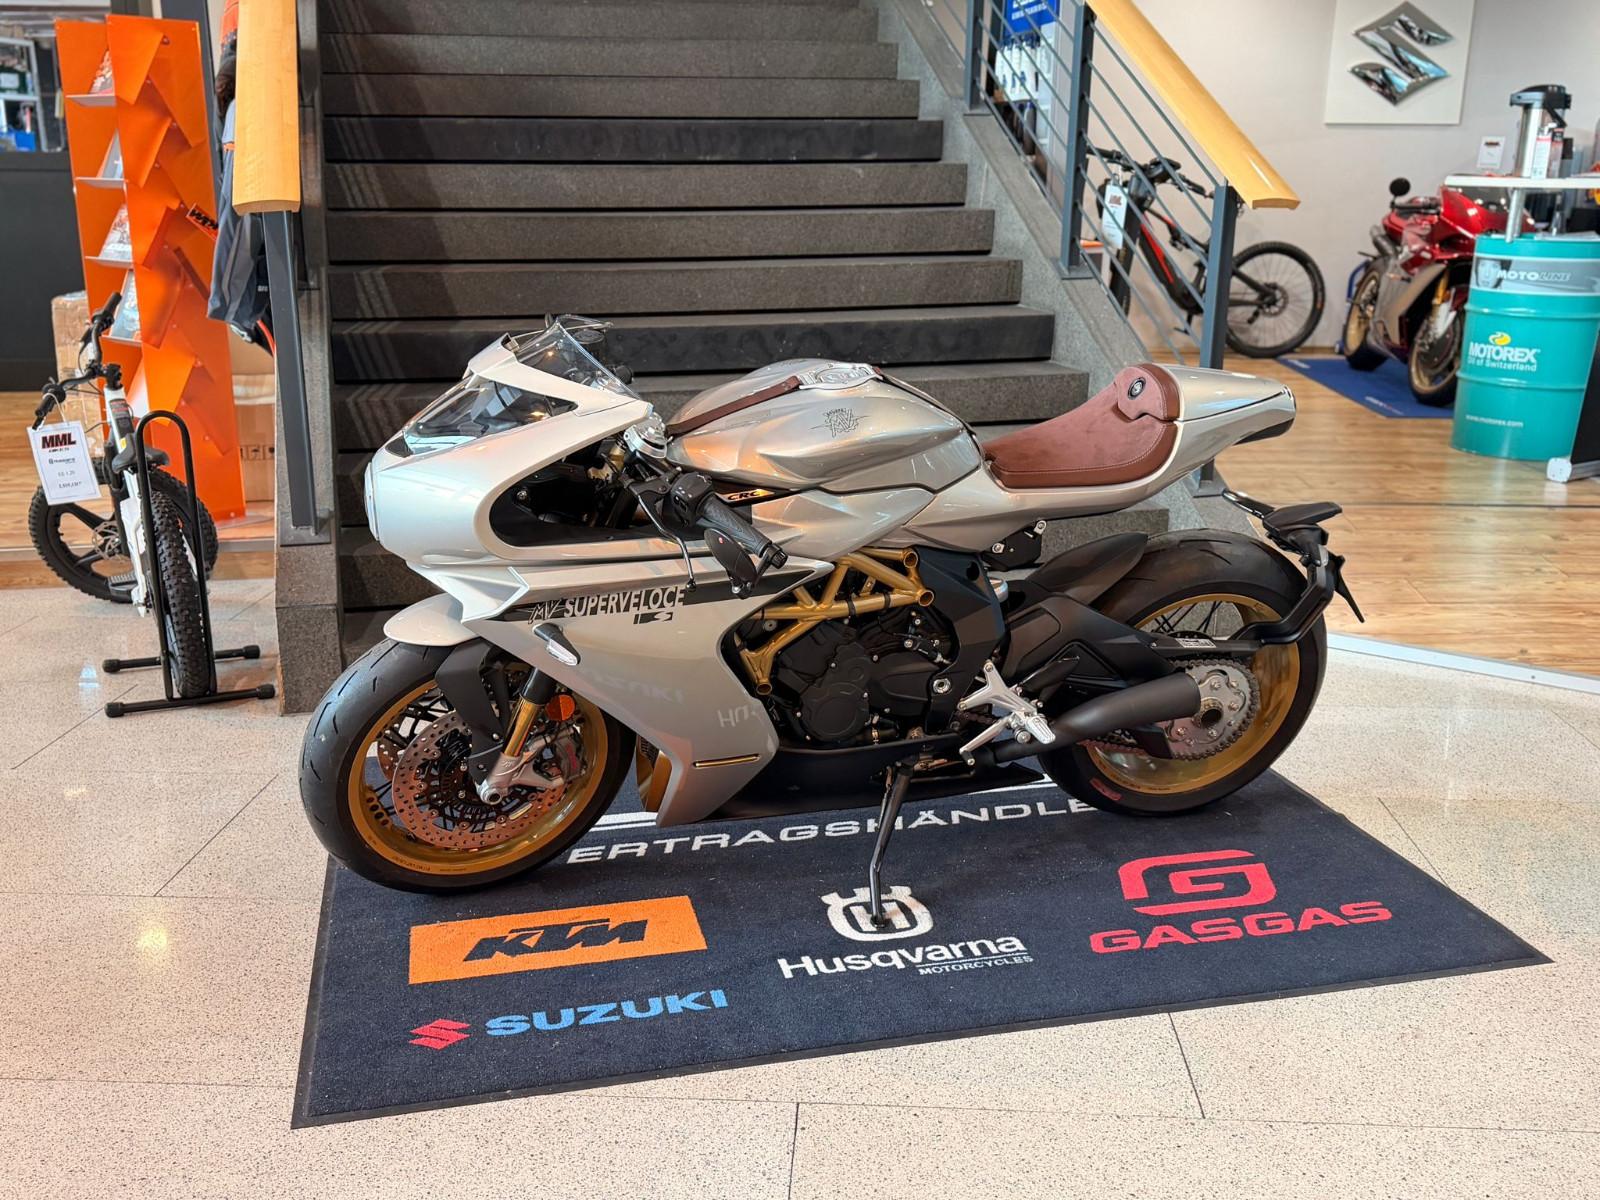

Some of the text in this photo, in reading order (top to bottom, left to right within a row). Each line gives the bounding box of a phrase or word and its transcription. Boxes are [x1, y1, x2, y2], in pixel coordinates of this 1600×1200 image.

[1469, 342, 1536, 363] MOTOREX
[1485, 361, 1537, 371] Switzerland
[42, 433, 76, 449] MML
[728, 490, 761, 500] CRC
[564, 587, 685, 618] SUPERVELOCE
[567, 798, 1098, 864] ERTRAGSHÄNDLE
[462, 918, 649, 962] KTM
[1089, 901, 1393, 954] GASGAS
[777, 936, 1027, 979] Husqvarna
[918, 955, 1034, 975] MOTORCYCLES
[485, 989, 729, 1036] SUZUKI
